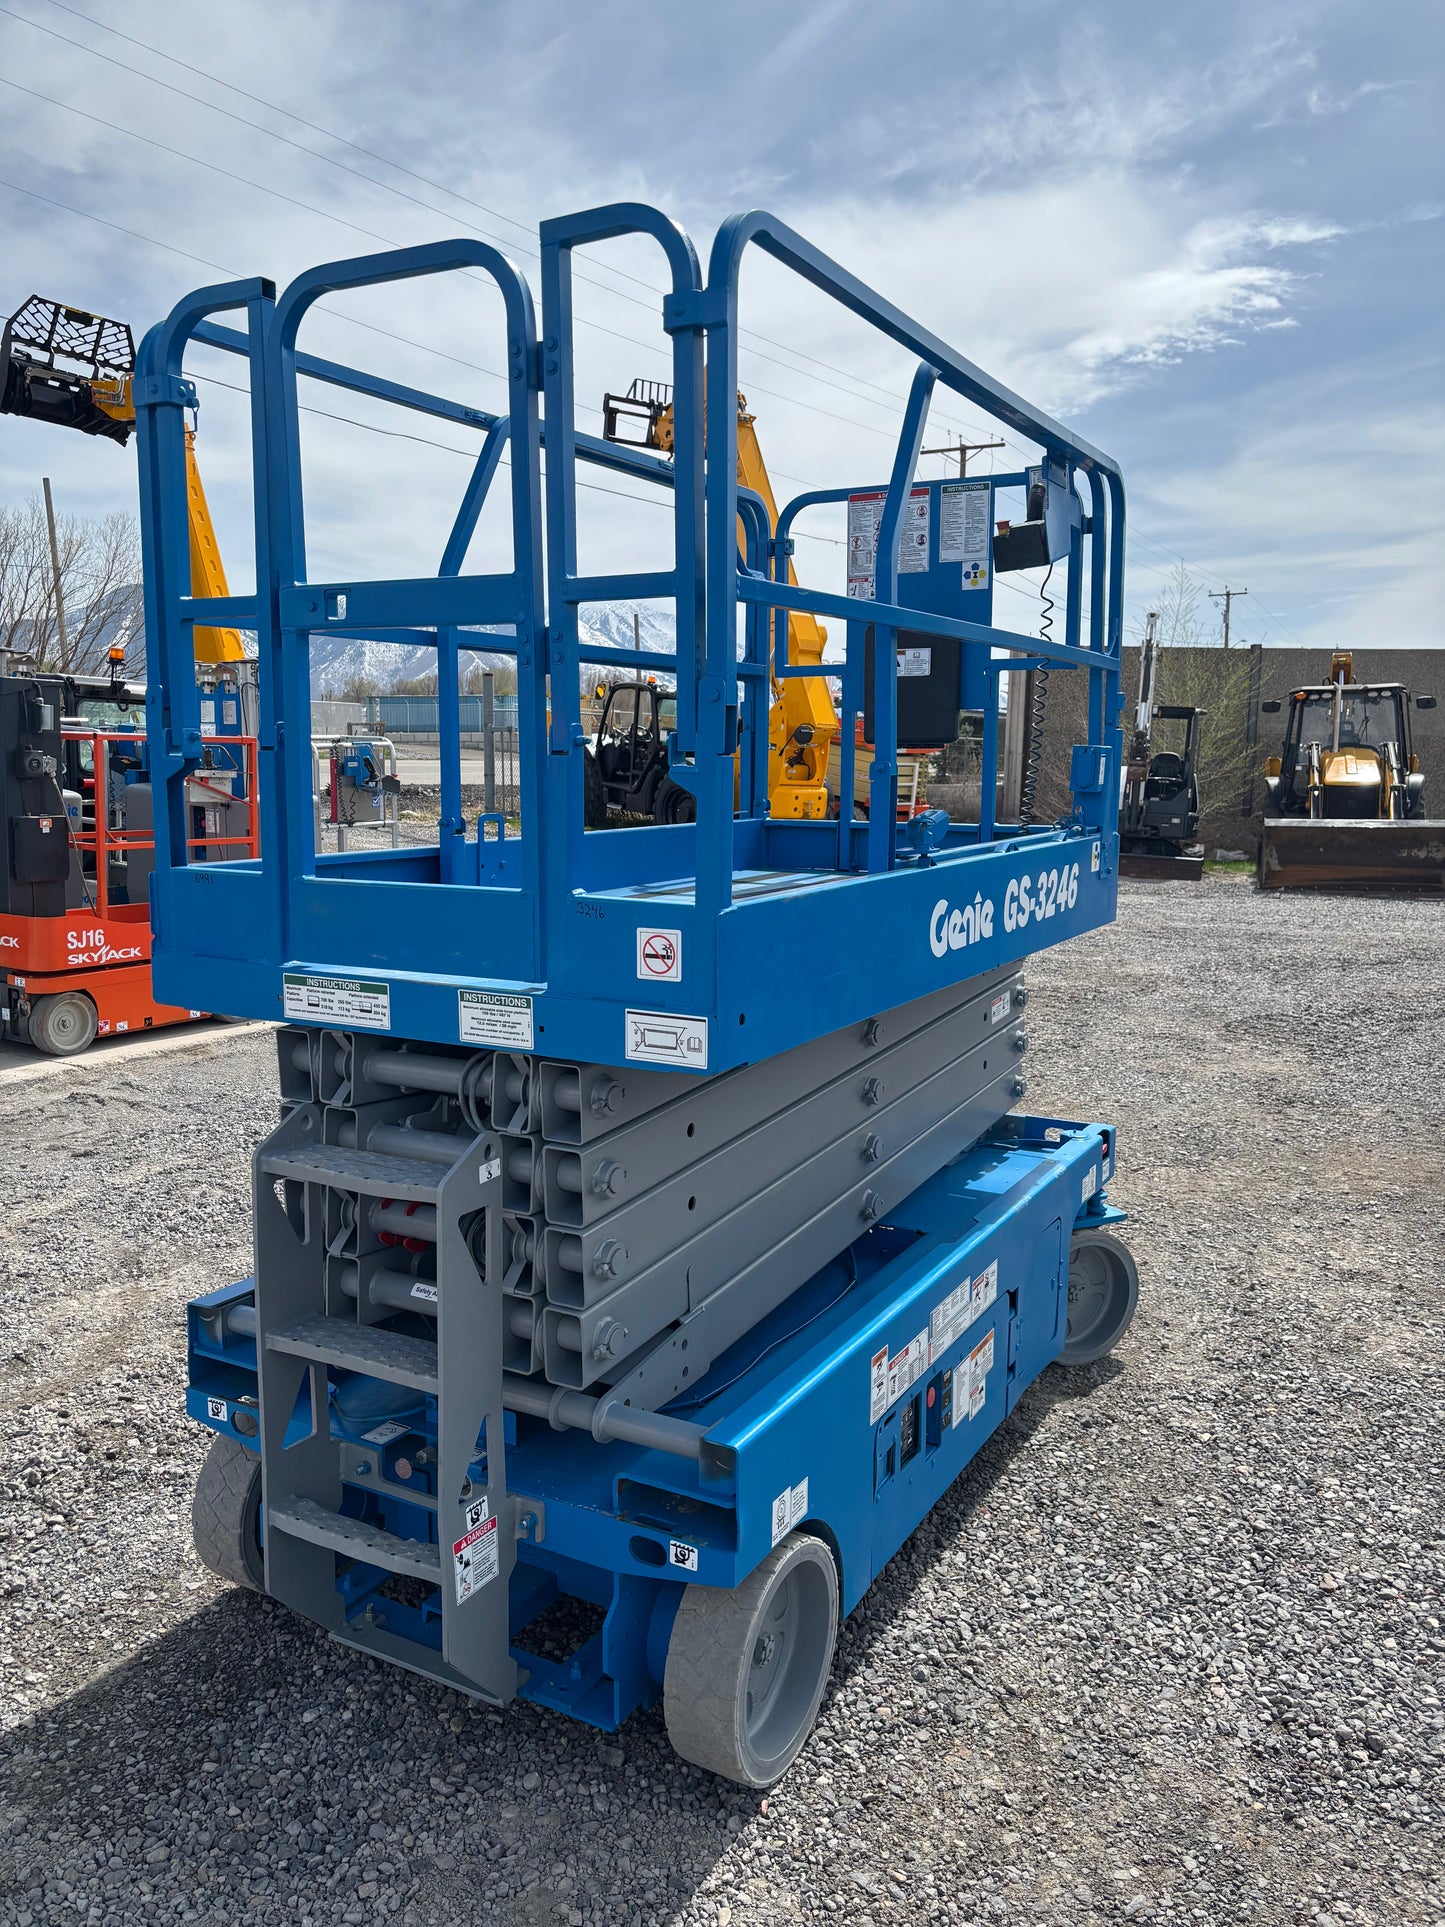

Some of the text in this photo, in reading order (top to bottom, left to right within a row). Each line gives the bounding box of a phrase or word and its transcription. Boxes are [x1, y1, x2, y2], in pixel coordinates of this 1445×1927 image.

[946, 484, 984, 492] INSTRUCTIONS
[576, 902, 604, 920] 3246
[930, 862, 1079, 958] Genie GS-3246
[0, 936, 19, 948] CK
[67, 929, 104, 949] SJ16
[68, 944, 142, 964] SKYJACK
[306, 978, 360, 991] INSTRUCTIONS
[464, 993, 527, 1007] INSTRUCTIONS
[416, 1287, 432, 1296] Safety
[467, 1522, 492, 1544] DANGER
